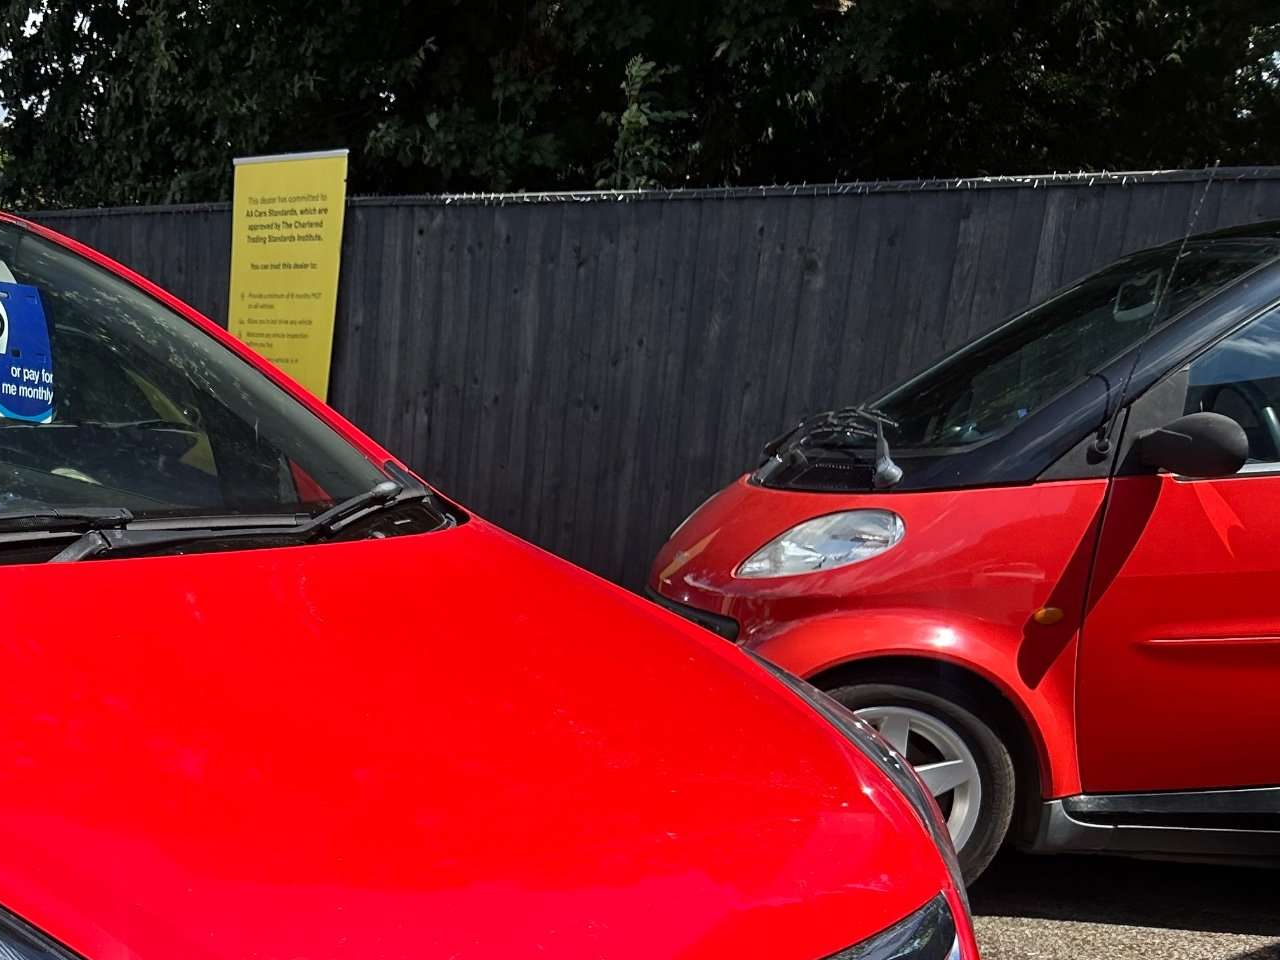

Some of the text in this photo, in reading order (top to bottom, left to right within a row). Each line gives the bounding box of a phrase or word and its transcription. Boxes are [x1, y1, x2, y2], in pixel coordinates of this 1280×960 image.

[288, 193, 320, 203] committed
[254, 209, 267, 217] Cars
[299, 207, 317, 215] which
[318, 207, 329, 215] are
[248, 222, 273, 231] approved
[282, 220, 293, 229] The
[294, 220, 324, 229] Chartered
[267, 234, 296, 243] Standards
[293, 262, 310, 270] dealer
[10, 366, 54, 385] or pay for
[2, 382, 54, 405] me monthly
